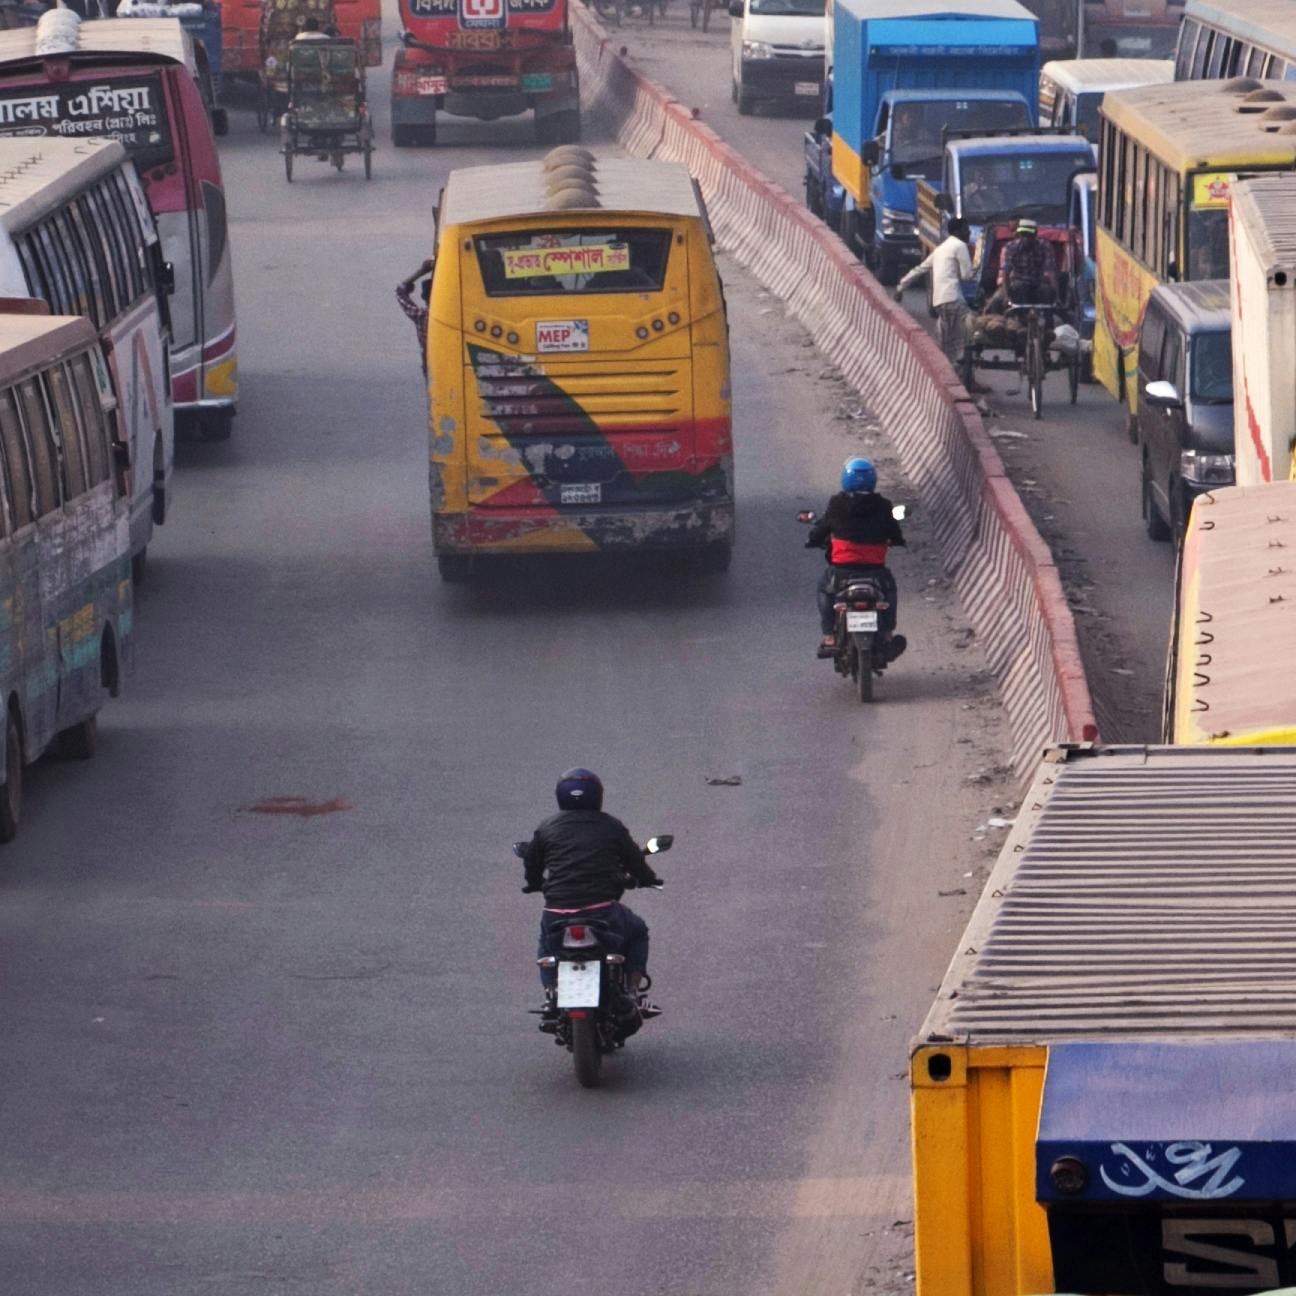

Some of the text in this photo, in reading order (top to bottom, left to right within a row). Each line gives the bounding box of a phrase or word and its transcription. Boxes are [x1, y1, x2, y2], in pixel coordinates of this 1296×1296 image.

[67, 85, 150, 115] এশিয়া
[52, 118, 103, 135] পরিবহন
[136, 112, 157, 126] লিঃ
[539, 329, 572, 344] MEP
